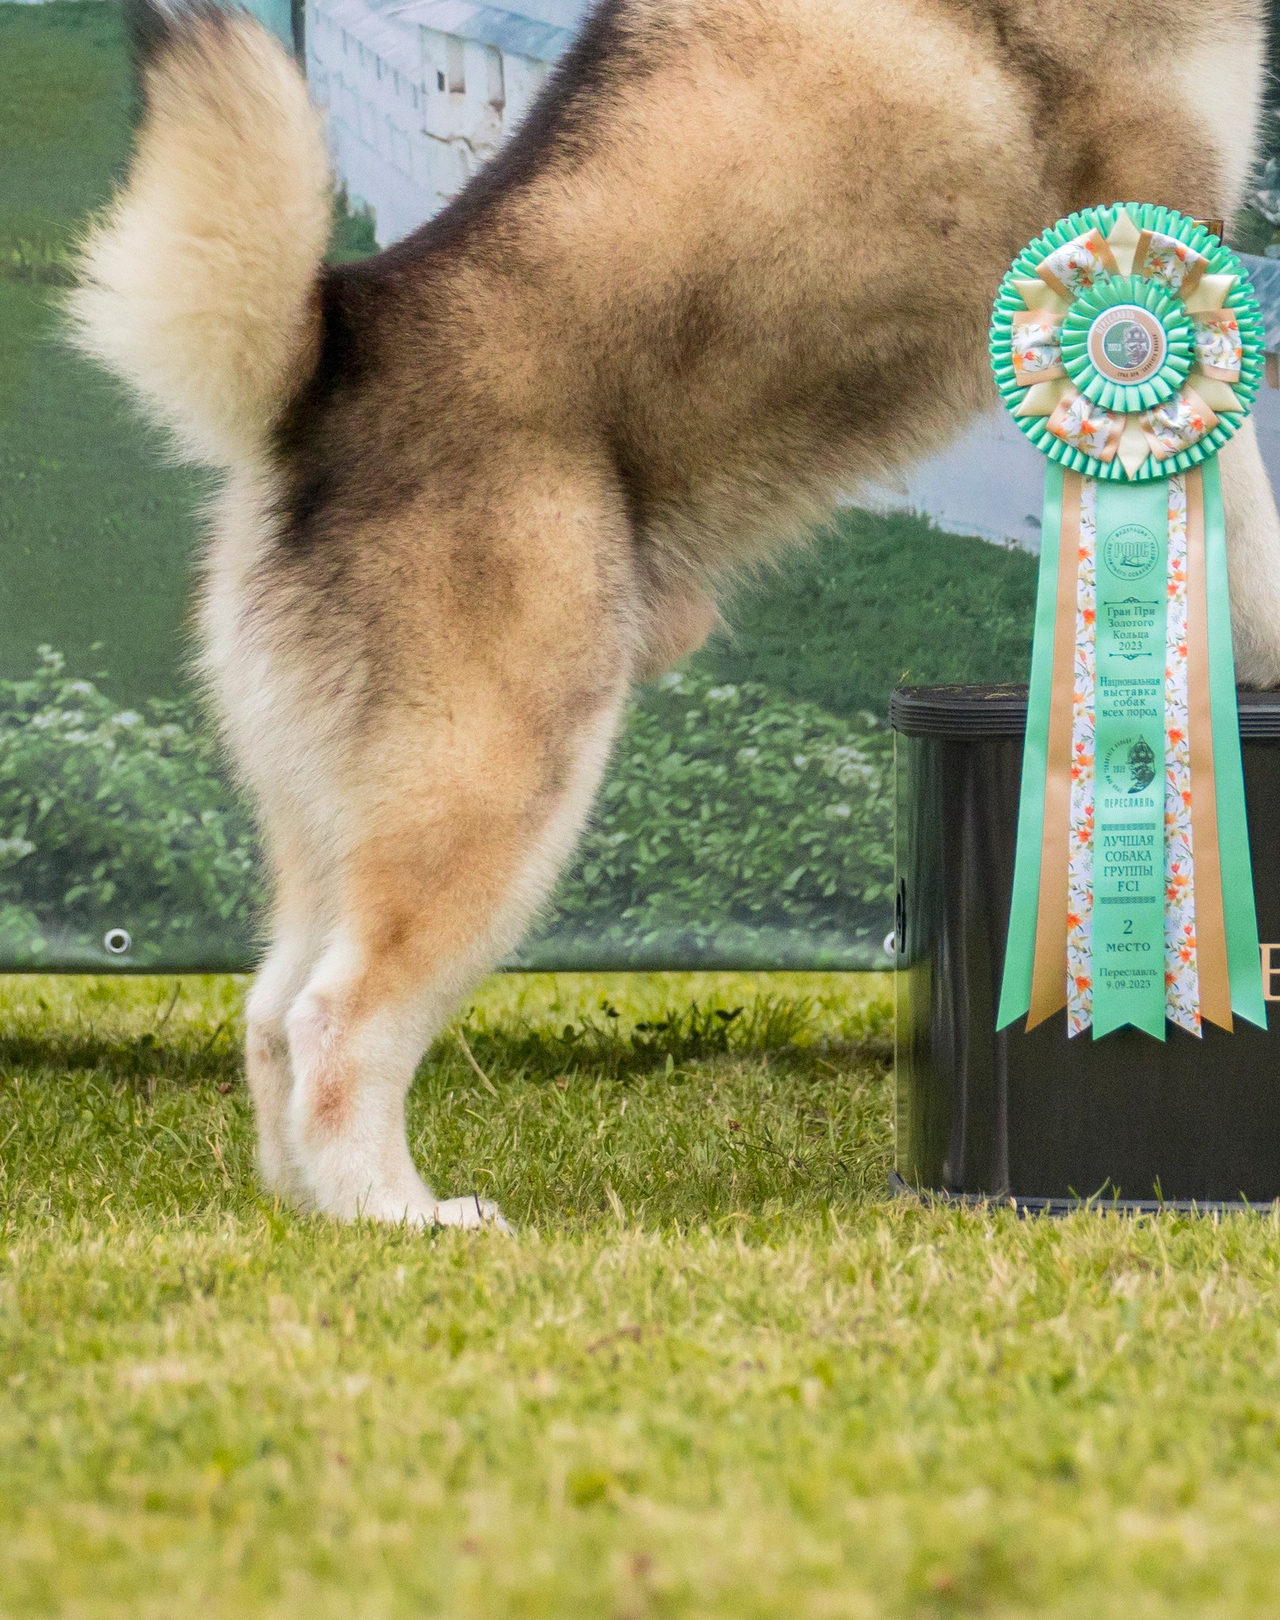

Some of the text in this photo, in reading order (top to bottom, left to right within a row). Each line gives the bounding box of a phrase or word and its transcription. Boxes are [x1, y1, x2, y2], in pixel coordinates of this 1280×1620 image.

[1107, 606, 1156, 619] Гран При
[1107, 618, 1155, 628] Золотого
[1113, 630, 1150, 640] Кольца
[1118, 641, 1143, 651] 2023
[1100, 676, 1161, 688] Национальная
[1103, 688, 1157, 697] выставка
[1113, 696, 1146, 707] собак
[1102, 708, 1158, 719] всех пород
[1104, 797, 1155, 809] ПЕРЕСЛАВЛЬ
[1103, 834, 1155, 847] ЛУЧШАЯ
[1105, 850, 1152, 862] СОБАКА
[1103, 865, 1154, 877] ГРУППЫ
[1117, 880, 1140, 893] FCI
[1123, 919, 1134, 935] 2
[1106, 941, 1151, 953] место
[1099, 967, 1158, 980] Переславль
[1106, 979, 1152, 990] 9.09.2023
